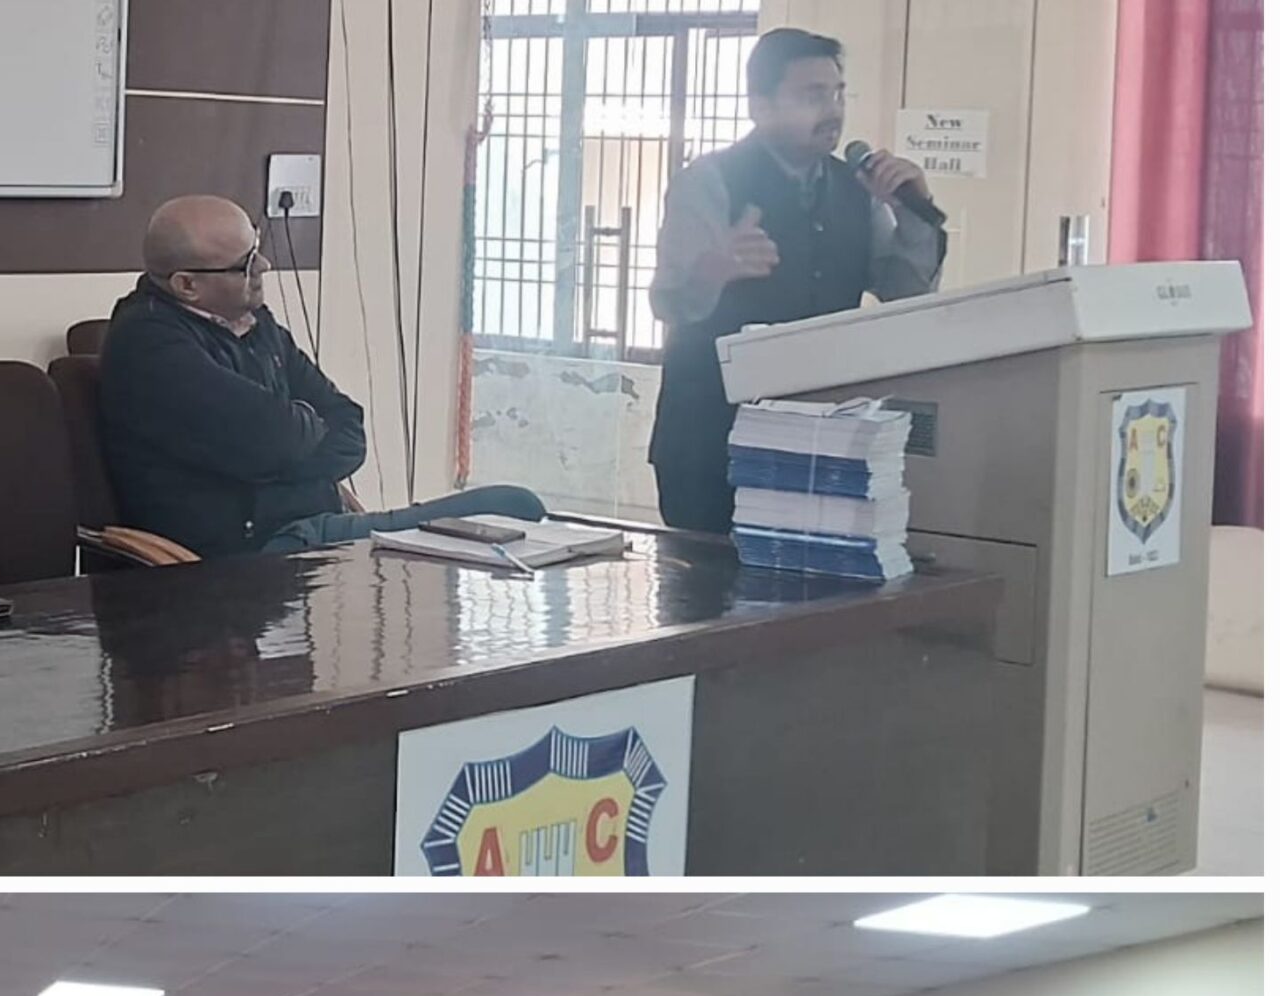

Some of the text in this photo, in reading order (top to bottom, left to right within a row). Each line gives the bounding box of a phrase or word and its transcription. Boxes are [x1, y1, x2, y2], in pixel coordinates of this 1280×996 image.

[924, 113, 961, 128] New
[906, 135, 981, 151] Seminar
[923, 156, 961, 171] Hall
[1156, 424, 1167, 447] C
[473, 797, 619, 876] A C
